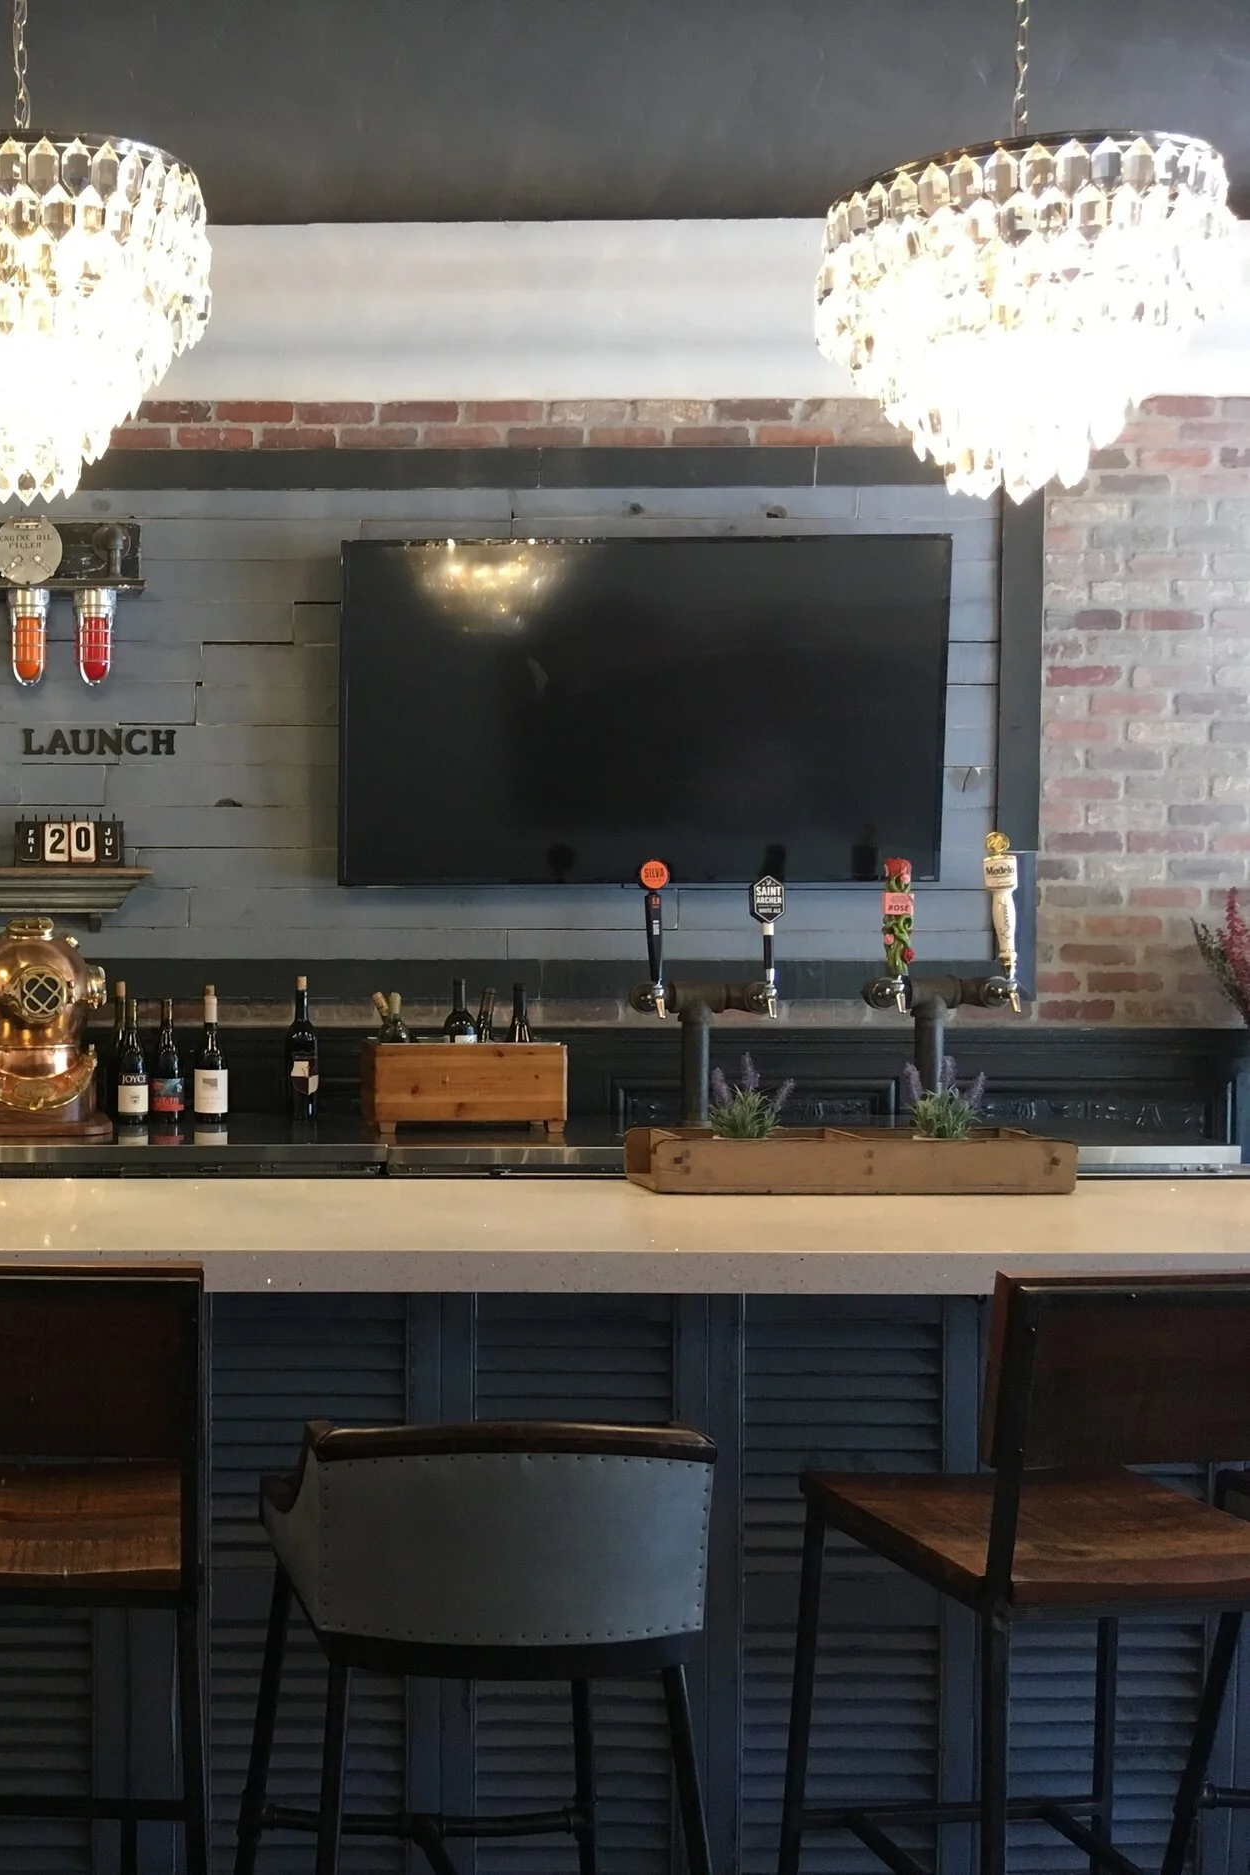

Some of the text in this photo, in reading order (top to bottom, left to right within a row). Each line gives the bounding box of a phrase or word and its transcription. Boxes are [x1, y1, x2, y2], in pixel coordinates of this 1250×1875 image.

[22, 728, 176, 755] LAUNCH
[27, 829, 35, 853] FRI
[49, 826, 91, 854] 20
[104, 828, 113, 856] JUL
[644, 867, 665, 879] SILVA
[985, 865, 1015, 875] Modelo
[756, 886, 782, 896] SAINT
[756, 896, 782, 904] ARCHER
[121, 1074, 147, 1085] JOYCE
